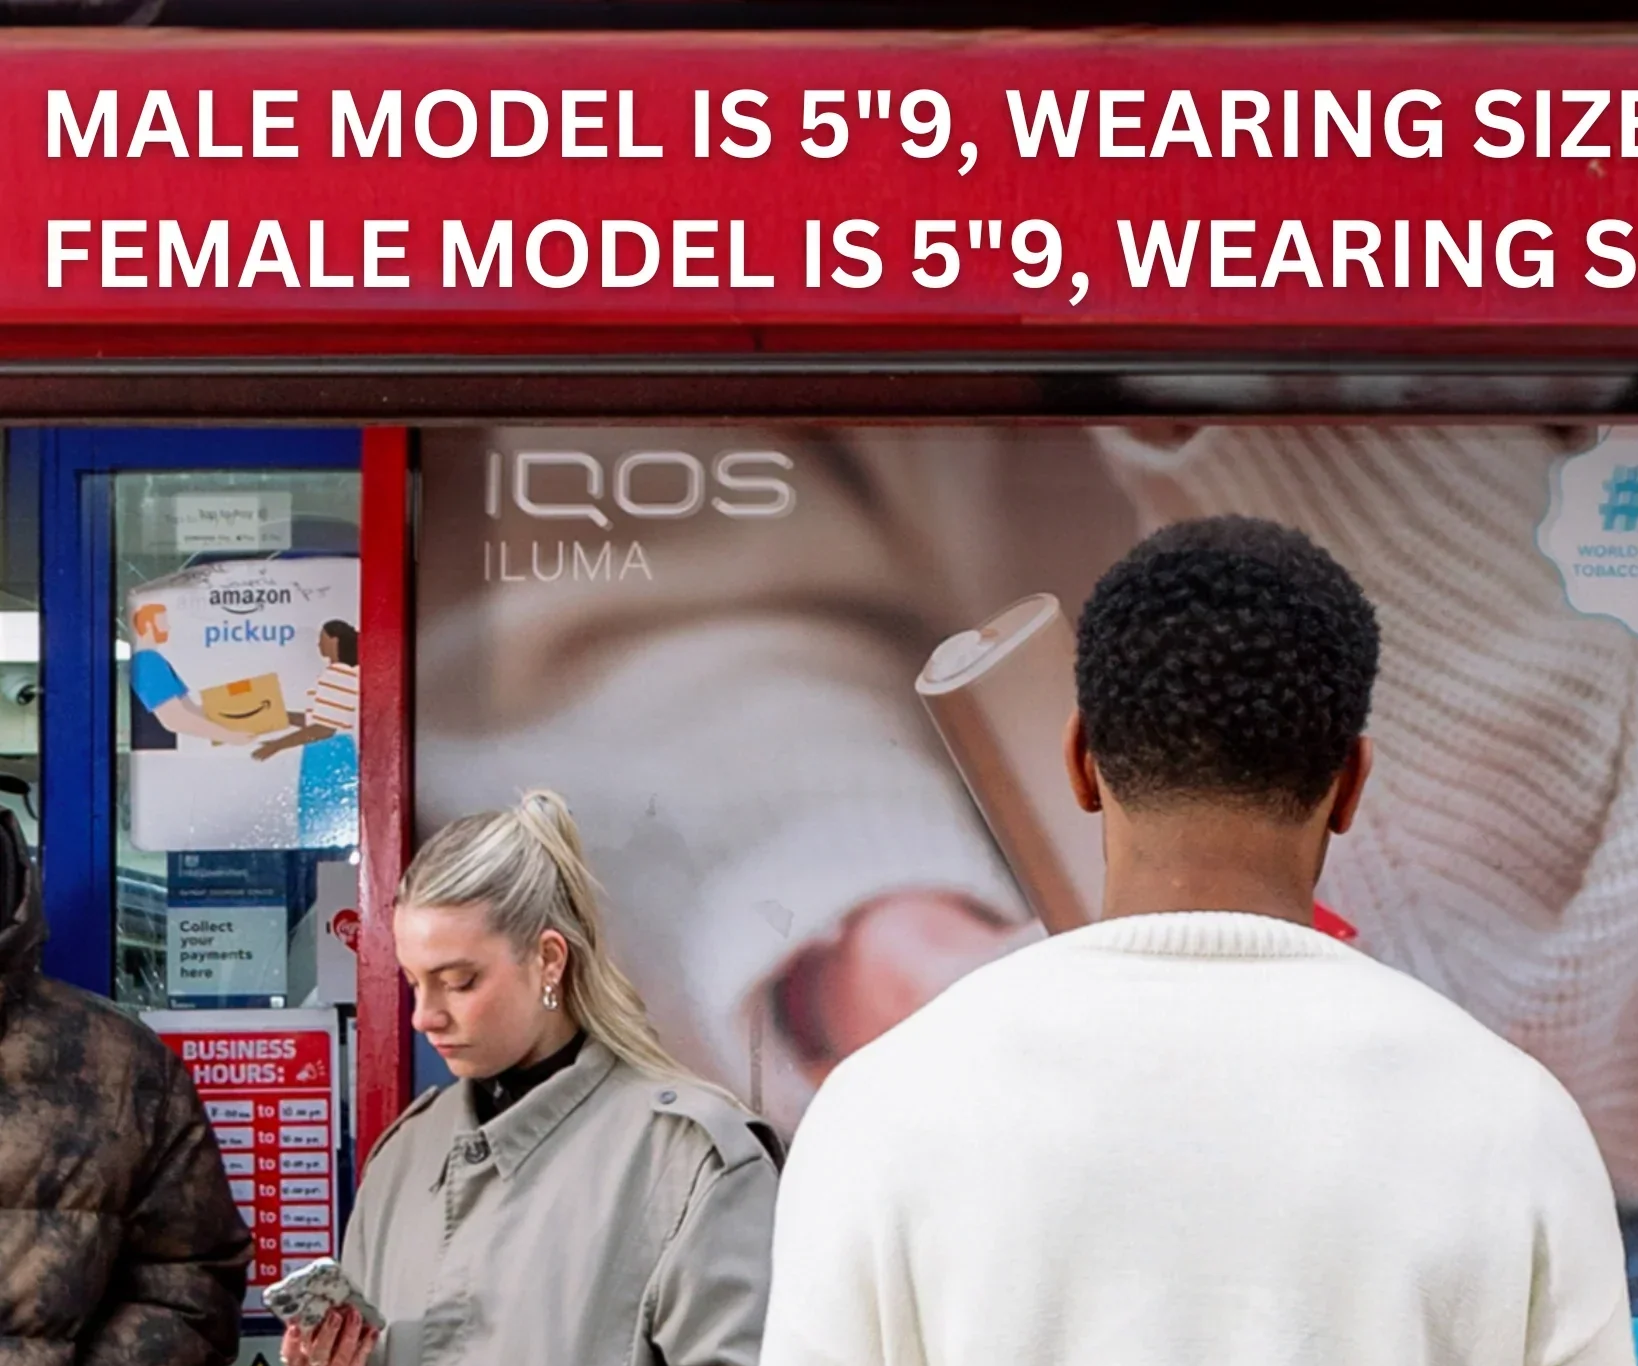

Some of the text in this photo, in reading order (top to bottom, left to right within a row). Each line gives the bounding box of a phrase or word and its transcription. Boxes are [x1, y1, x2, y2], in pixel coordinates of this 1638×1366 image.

[485, 449, 795, 530] IQOS
[484, 541, 653, 582] ILUMA
[209, 588, 291, 605] amazon
[205, 620, 295, 647] pickup
[180, 920, 233, 933] Collect
[180, 935, 214, 948] your
[180, 950, 253, 963] payments
[180, 966, 213, 979] here
[182, 1039, 297, 1060] BUSINESS
[193, 1063, 286, 1084] HOURS:
[258, 1104, 275, 1118] to
[259, 1131, 276, 1144] to
[259, 1157, 276, 1171] to
[259, 1184, 276, 1197] to
[260, 1210, 276, 1223] to
[260, 1237, 276, 1250] to
[260, 1263, 276, 1276] to
